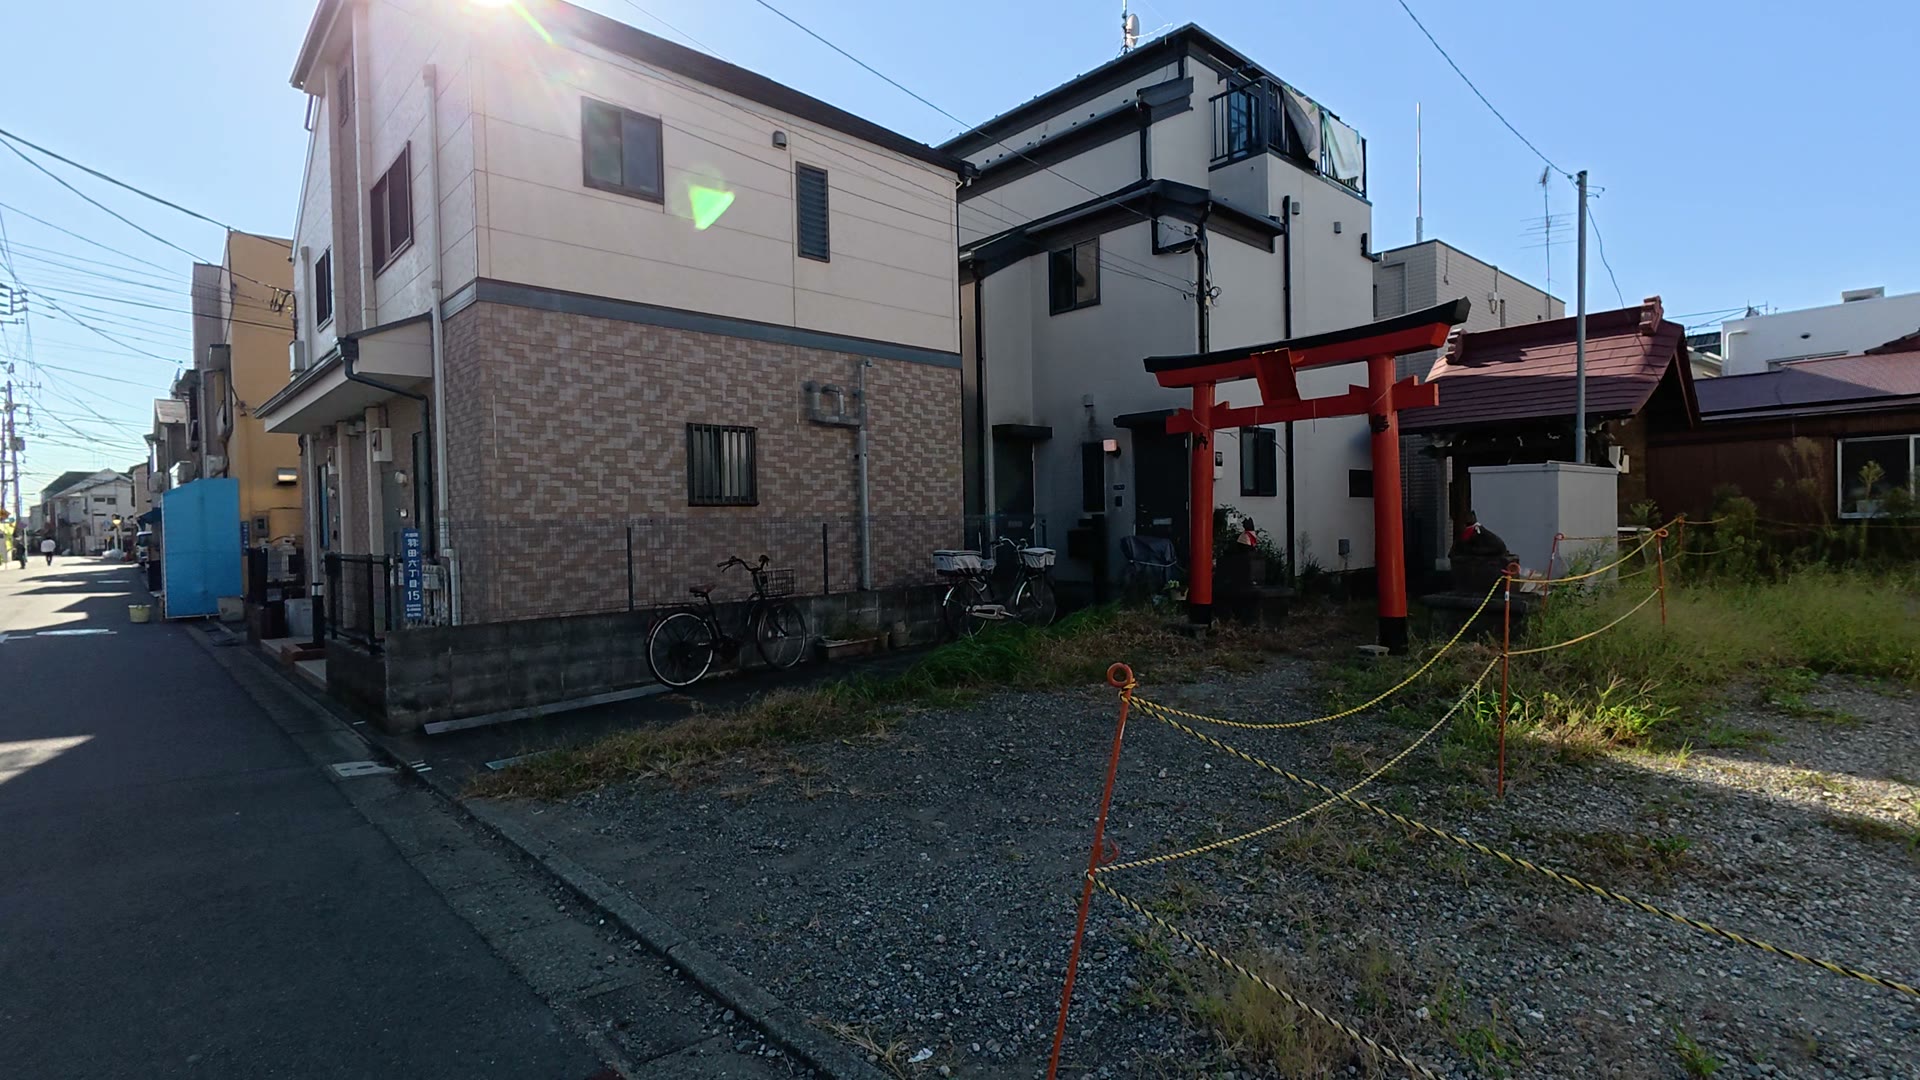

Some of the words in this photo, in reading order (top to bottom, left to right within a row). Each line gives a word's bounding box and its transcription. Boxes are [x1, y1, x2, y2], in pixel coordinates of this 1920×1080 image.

[407, 538, 417, 588] 羽田六丁目
[407, 590, 420, 601] 15
